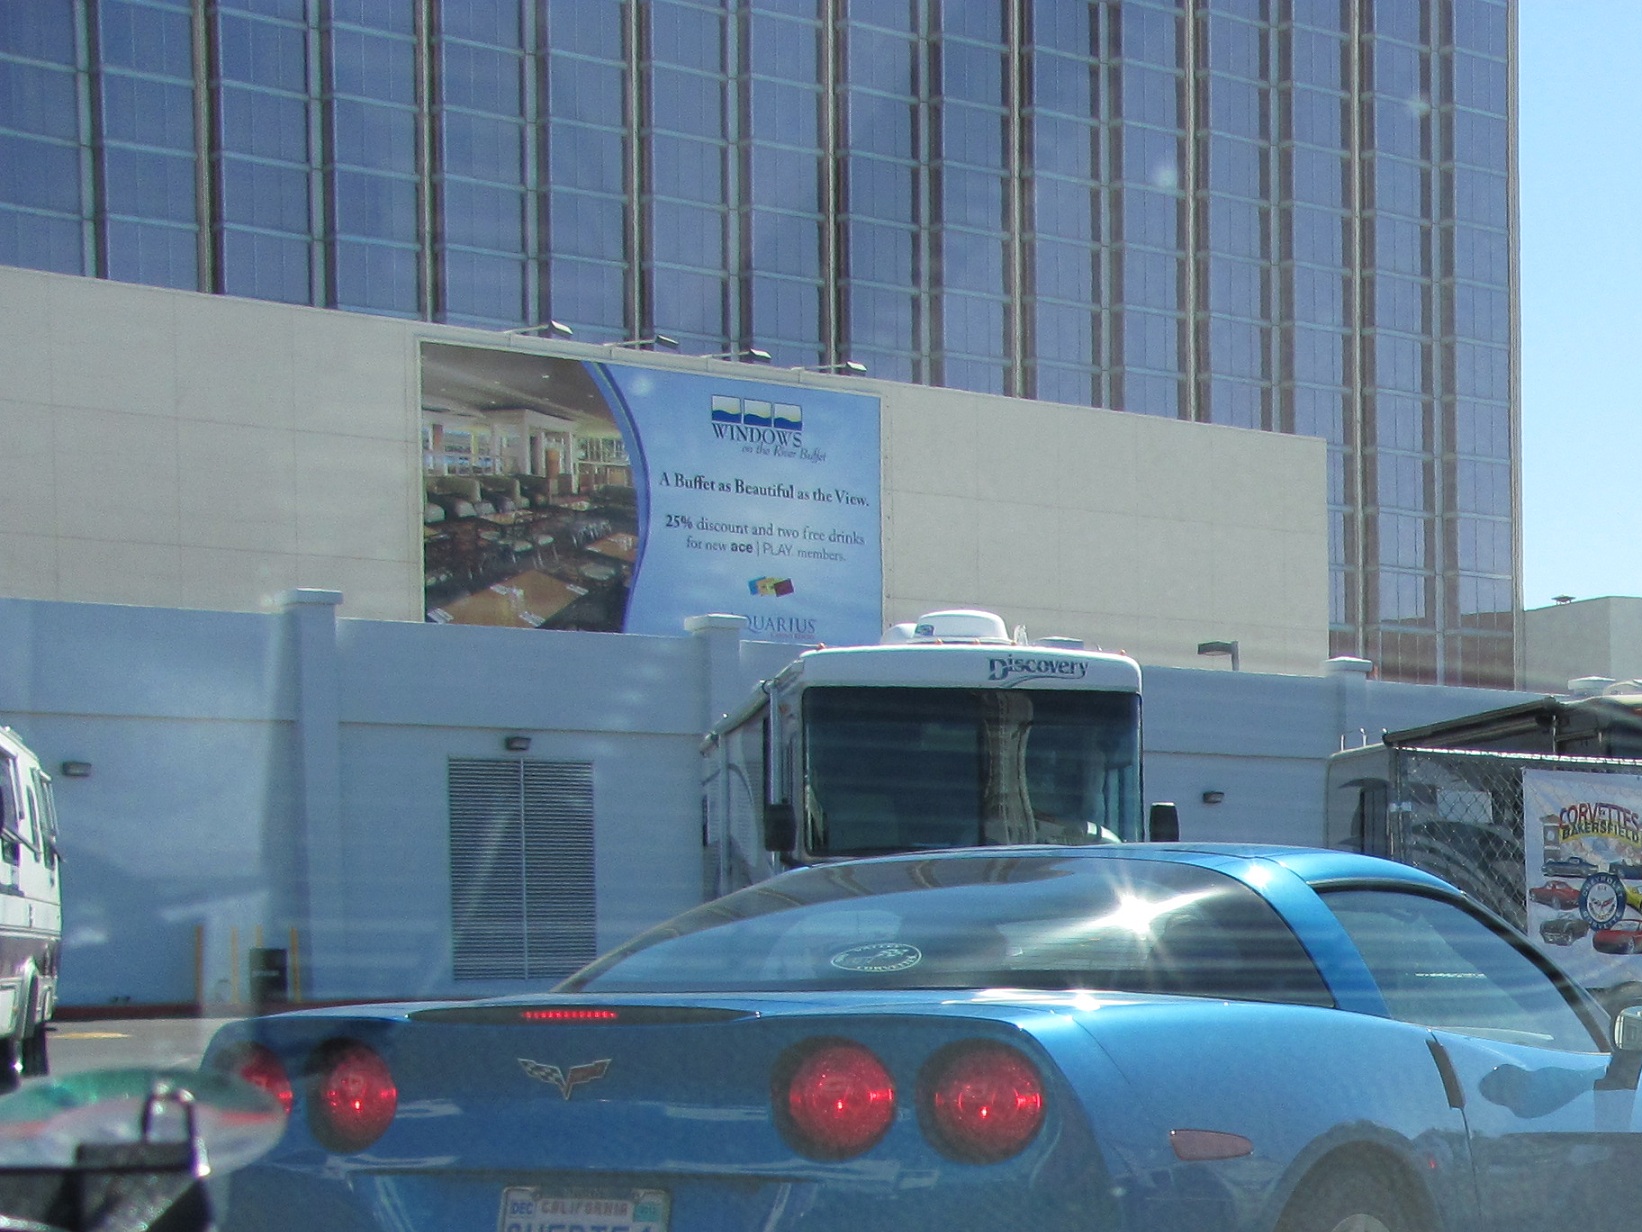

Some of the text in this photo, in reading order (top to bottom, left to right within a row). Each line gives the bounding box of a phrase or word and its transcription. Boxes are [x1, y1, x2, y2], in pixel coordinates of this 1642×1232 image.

[712, 423, 802, 448] WINDOWS
[756, 442, 770, 456] the
[800, 447, 826, 464] Buffet
[659, 472, 870, 507] A Buffet as Beautiful as the View.
[665, 514, 866, 546] 25% discount and two free drinks
[686, 536, 702, 549] for
[705, 540, 727, 551] new
[730, 542, 753, 554] ace
[797, 550, 847, 562] members.
[746, 614, 817, 635] QUARIUS
[985, 653, 1089, 681] Discovery
[1559, 803, 1641, 831] CORVETTES
[1562, 820, 1640, 843] BAKERSFIELD
[511, 1201, 534, 1216] DEC
